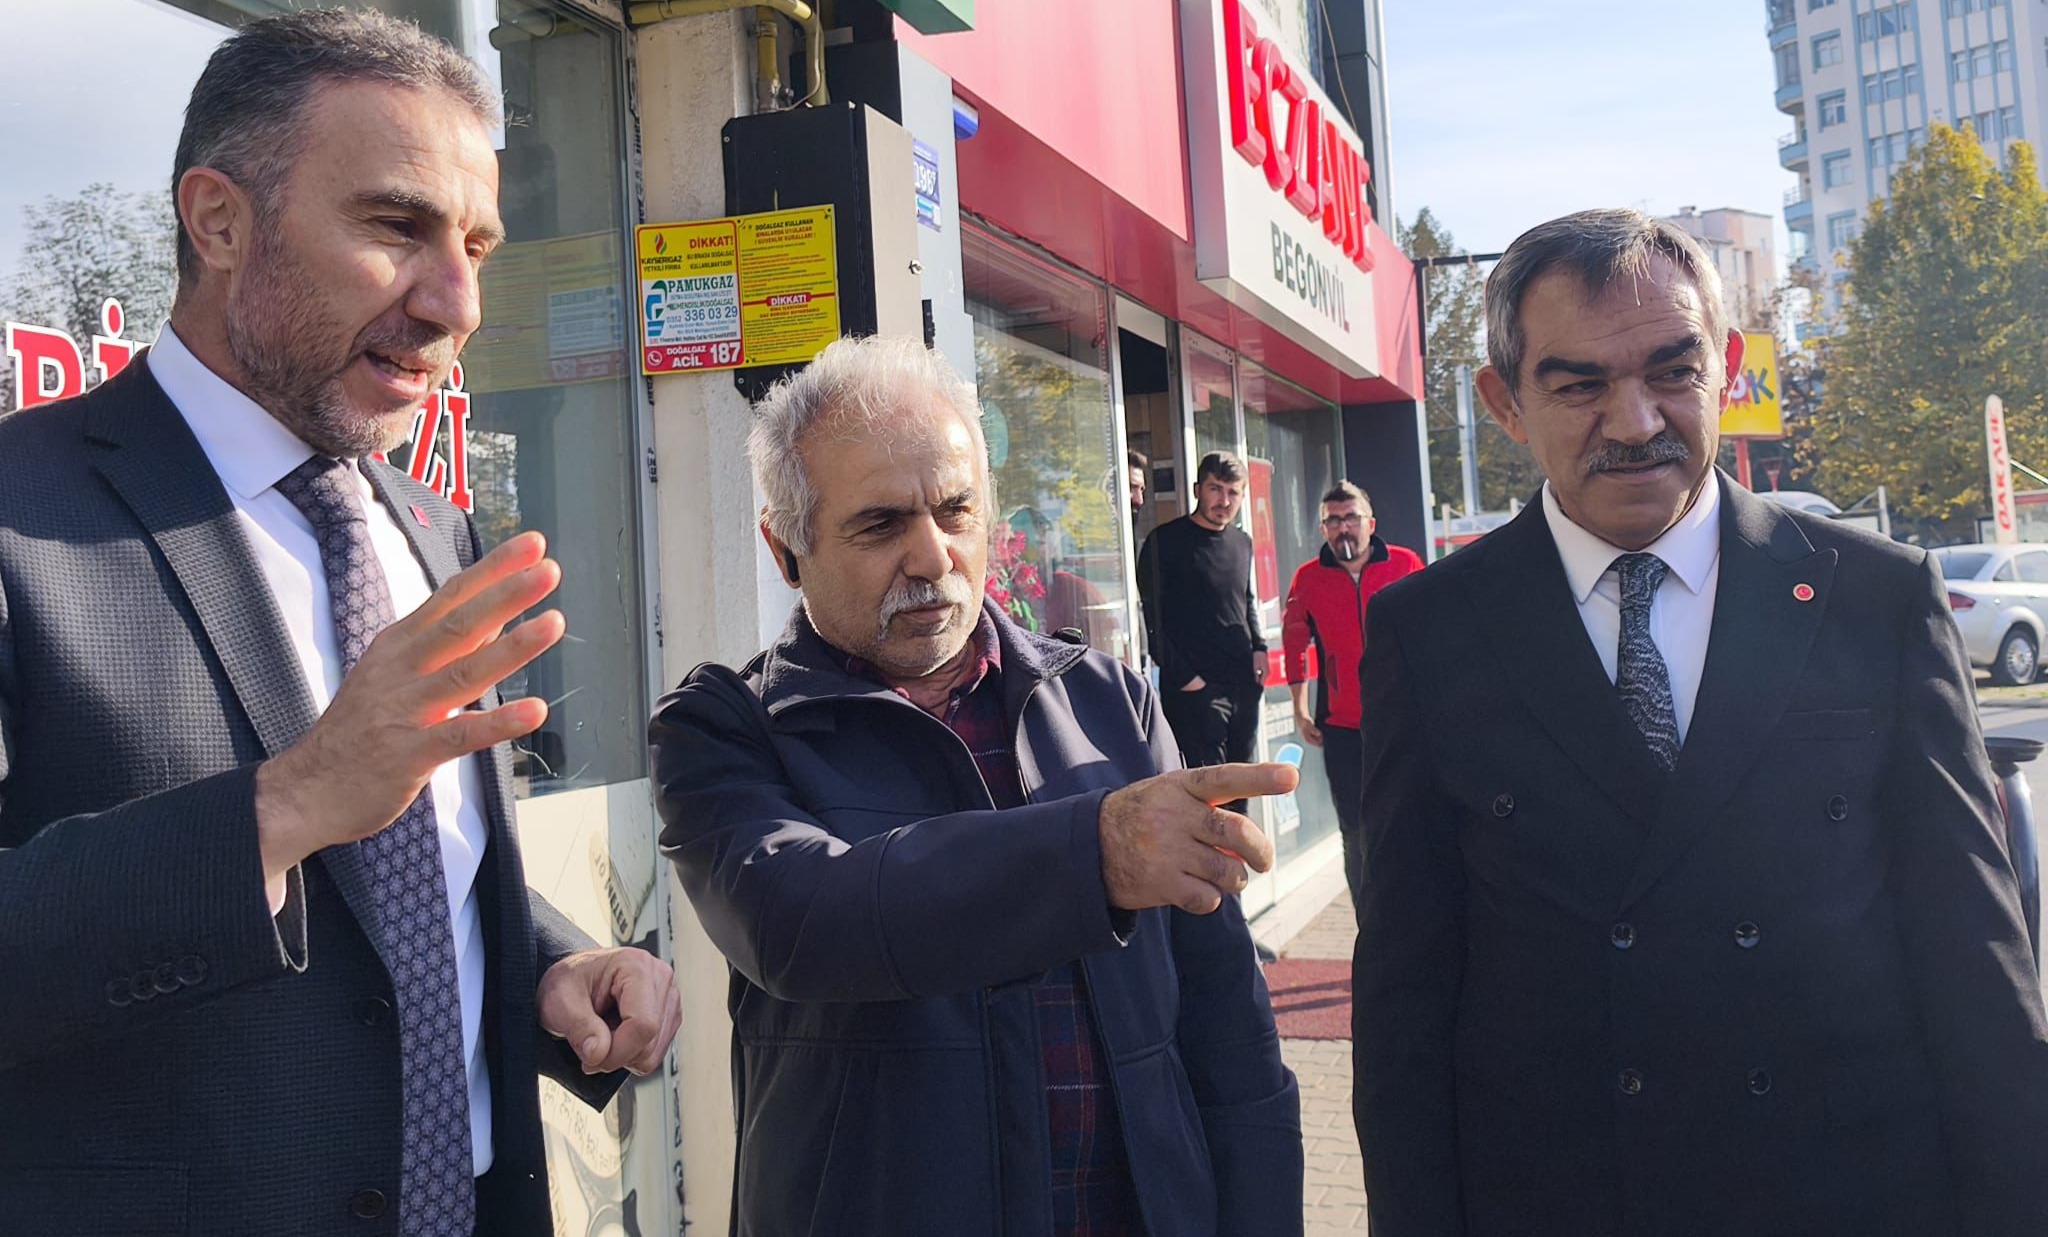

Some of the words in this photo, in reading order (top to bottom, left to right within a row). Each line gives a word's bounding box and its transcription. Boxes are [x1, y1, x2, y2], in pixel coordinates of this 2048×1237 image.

[1223, 0, 1375, 274] ECZANE
[668, 275, 734, 292] PAMUKGAZ
[1270, 220, 1350, 334] BEGONVİL
[684, 309, 706, 322] 336
[708, 307, 722, 320] 03
[724, 306, 738, 318] 29
[666, 345, 706, 355] DOĞALGAZ
[672, 354, 703, 368] ACİL
[710, 342, 741, 364] 187
